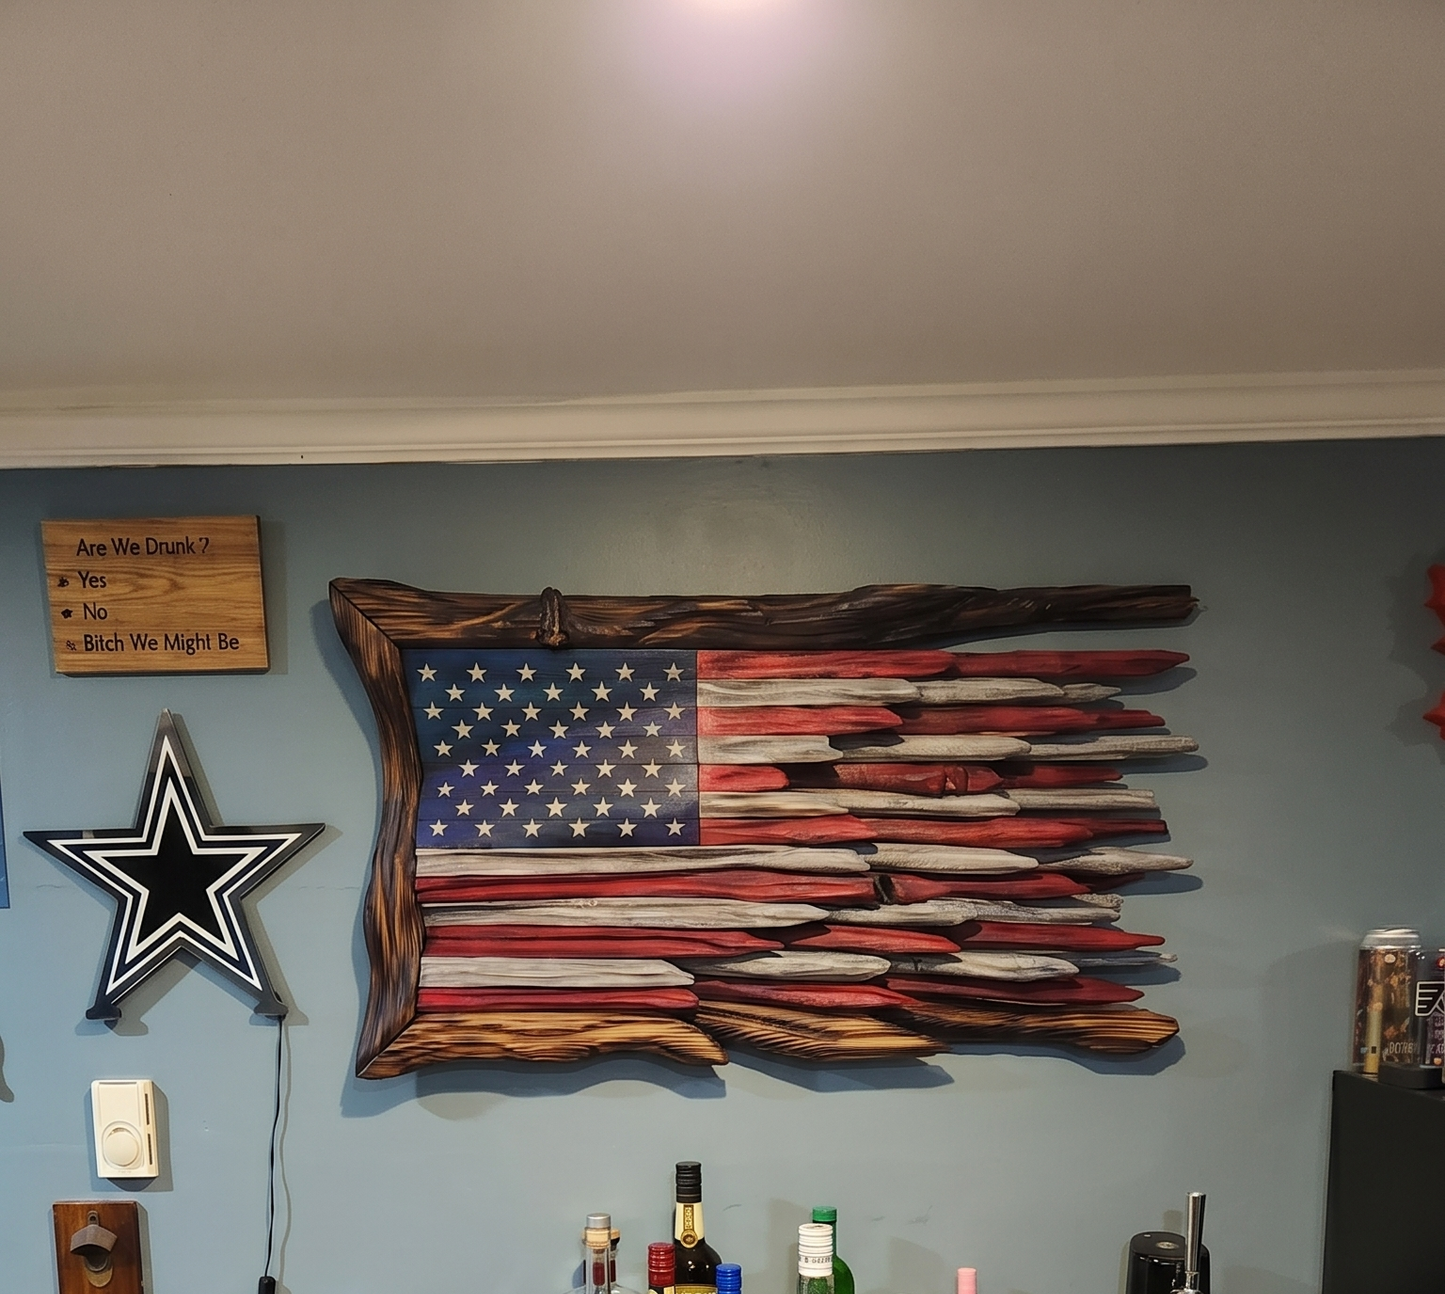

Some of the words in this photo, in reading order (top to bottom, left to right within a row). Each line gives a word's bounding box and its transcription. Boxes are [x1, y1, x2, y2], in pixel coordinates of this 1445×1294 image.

[76, 538, 107, 556] Are
[111, 538, 140, 555] We
[146, 536, 196, 555] Drunk
[78, 571, 107, 588] Yes
[83, 602, 108, 620] No
[84, 632, 124, 651] Bitch
[129, 634, 158, 650] We
[164, 633, 212, 655] Might
[218, 633, 240, 650] Be
